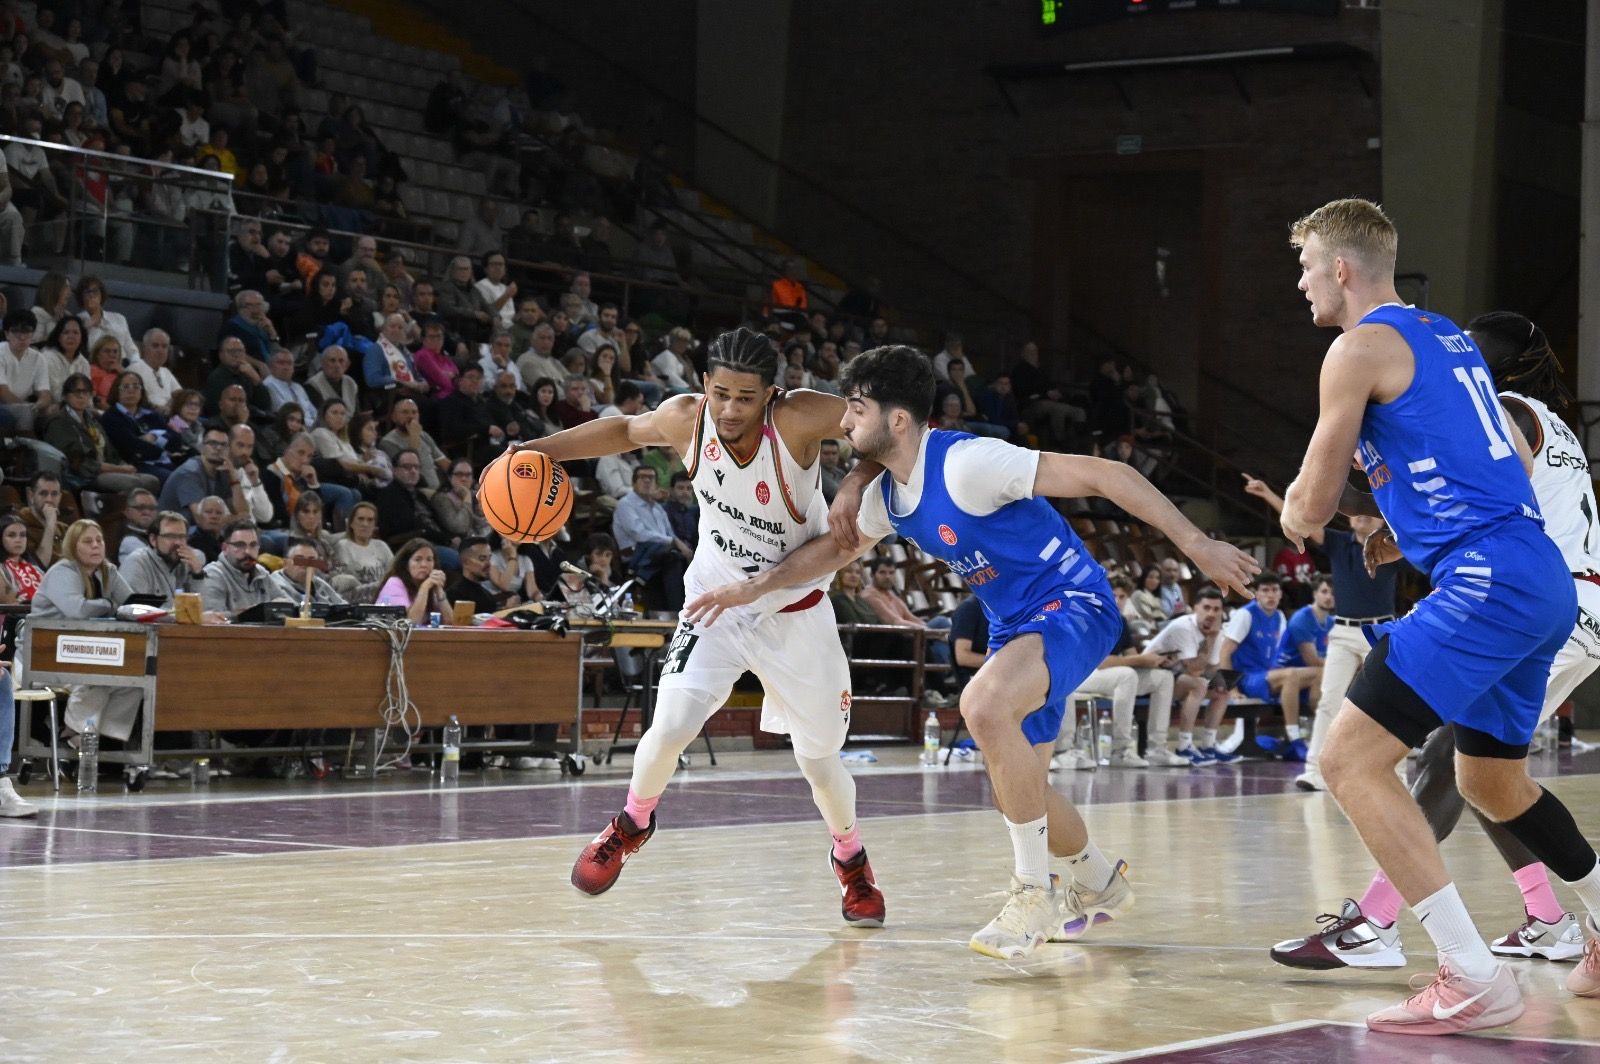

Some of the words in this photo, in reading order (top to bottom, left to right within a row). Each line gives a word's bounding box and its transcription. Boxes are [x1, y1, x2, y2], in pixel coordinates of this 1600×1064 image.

[1452, 366, 1517, 461] 10
[717, 502, 746, 524] CAJA
[749, 515, 786, 535] RURAL
[62, 644, 94, 655] PROHIBIDO
[95, 646, 118, 656] FUMAR
